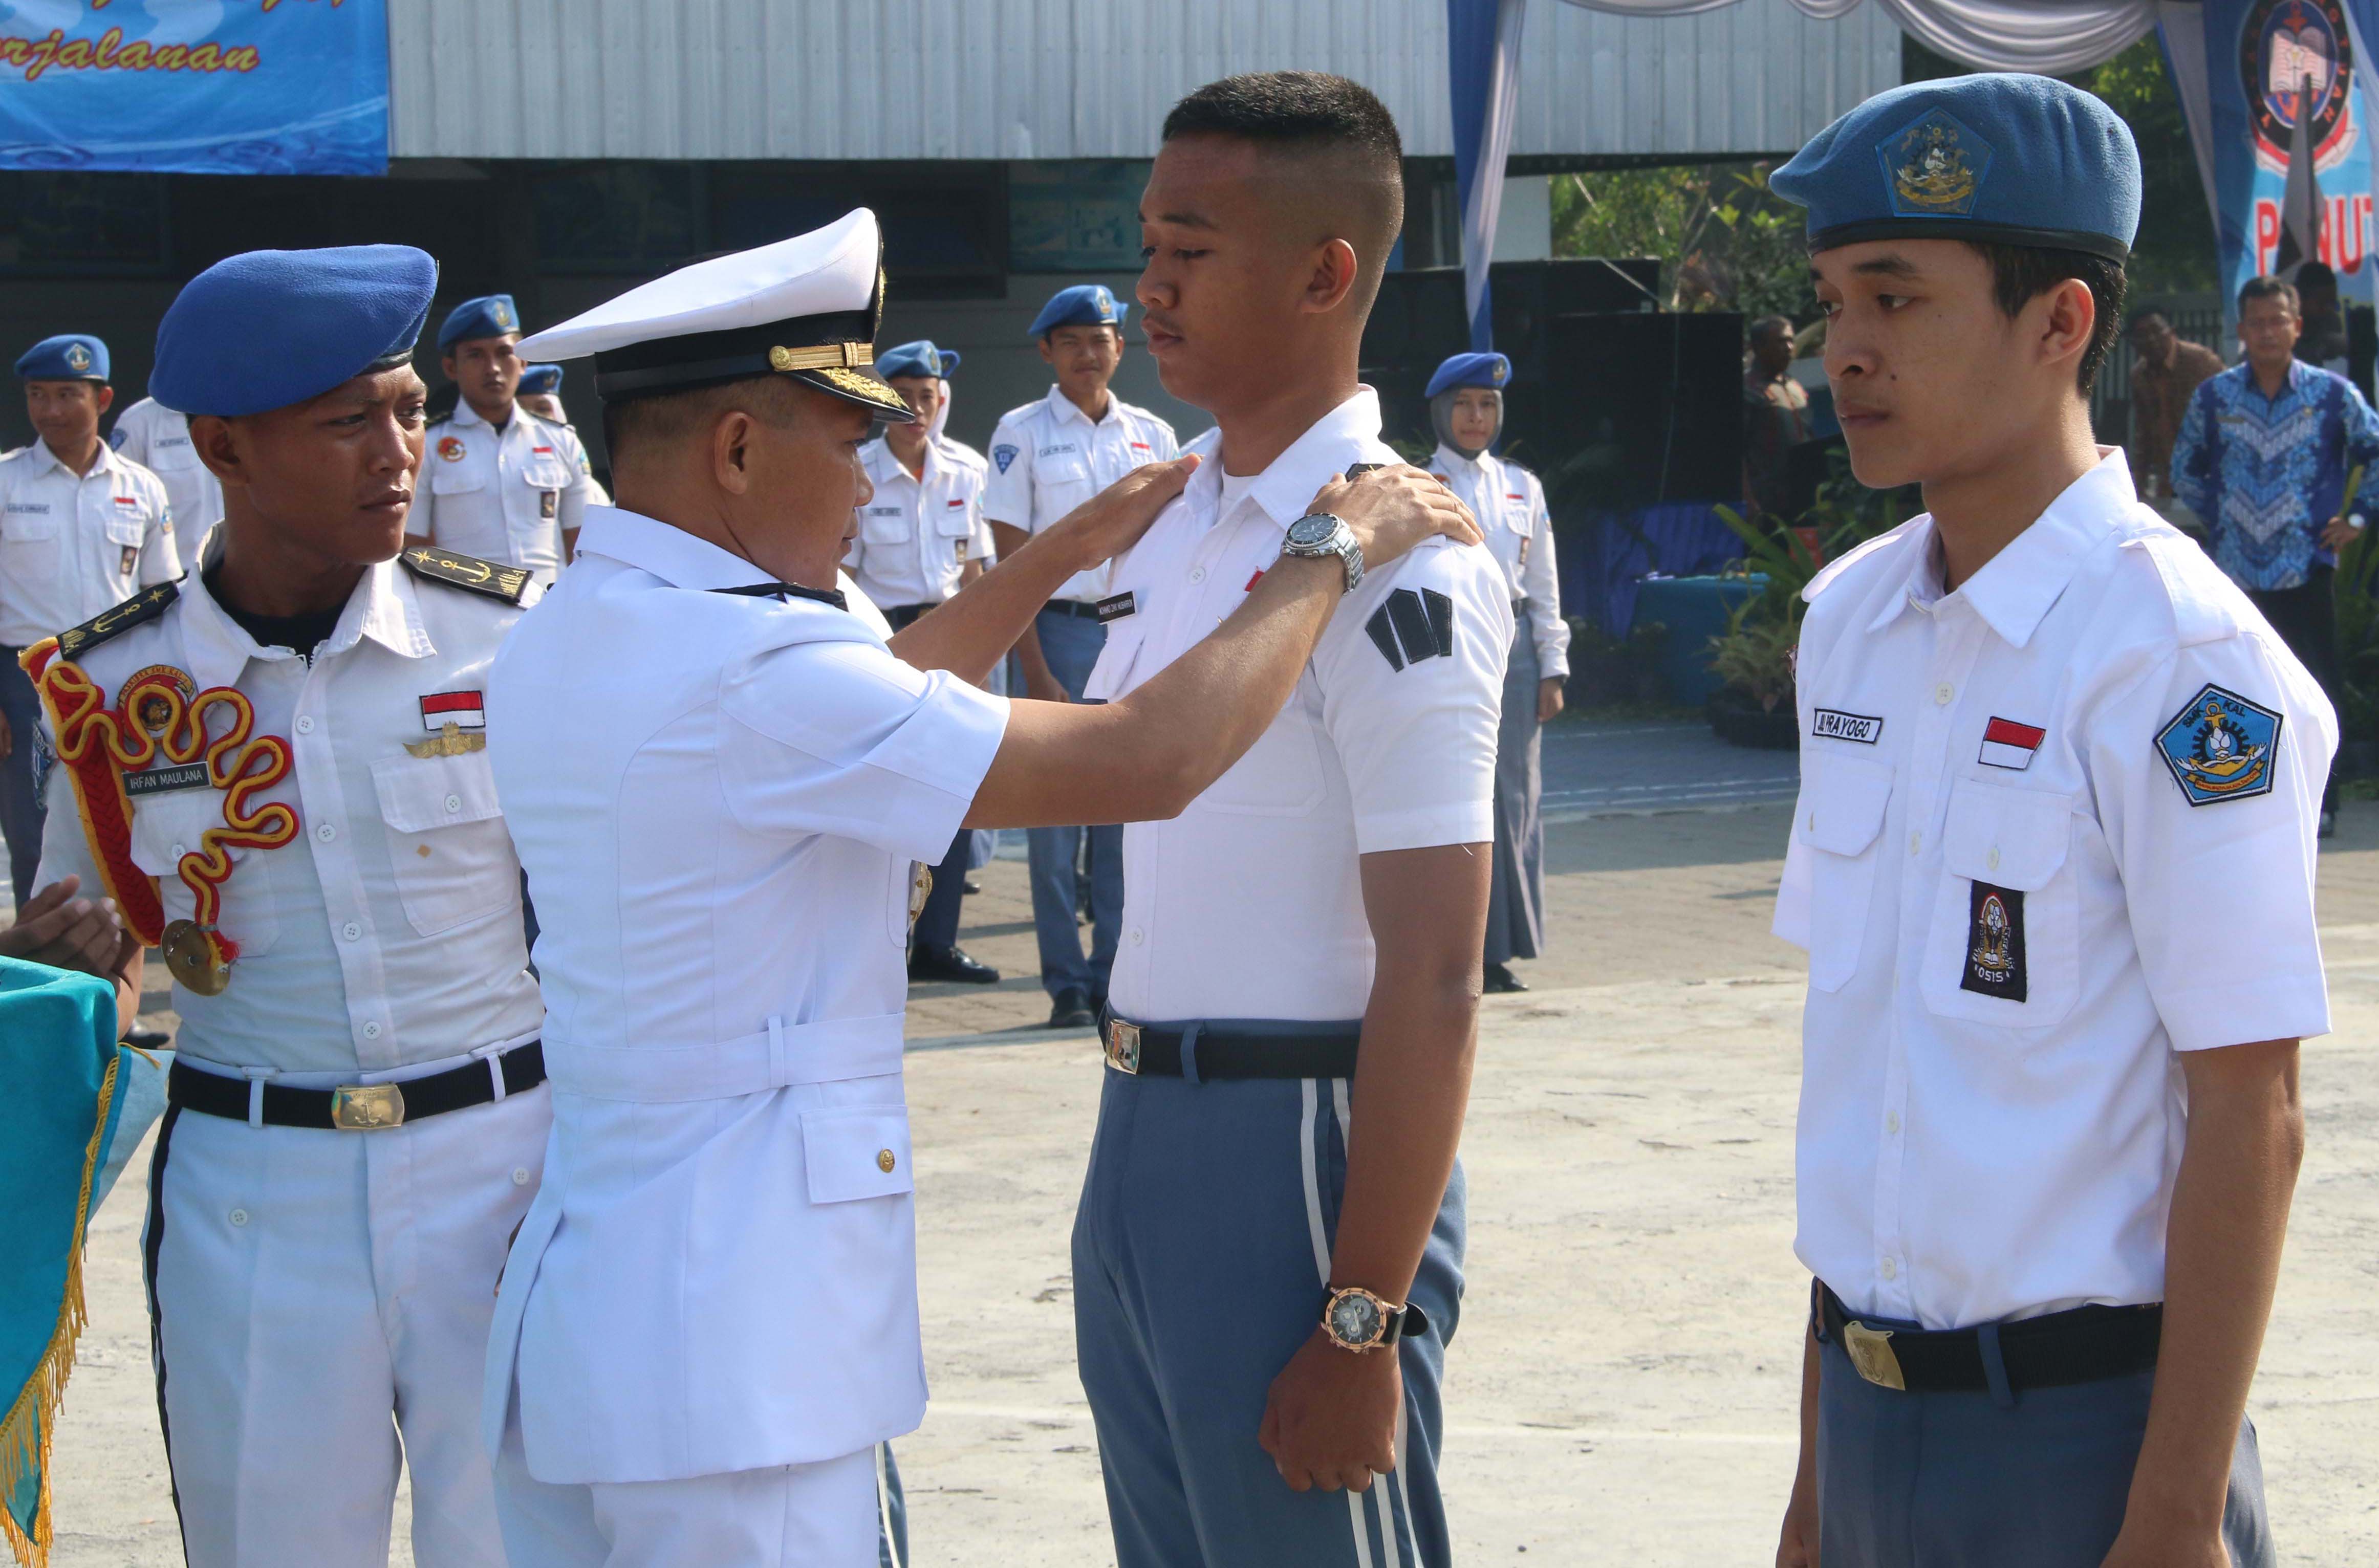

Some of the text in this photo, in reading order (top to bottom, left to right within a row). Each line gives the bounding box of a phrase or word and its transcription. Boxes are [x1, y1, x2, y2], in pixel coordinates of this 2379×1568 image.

[0, 27, 259, 81] rjalanan
[2182, 700, 2245, 728] SMK KAL
[129, 769, 203, 789] IRFAN MAULANA
[1978, 967, 2004, 982] OSIS
